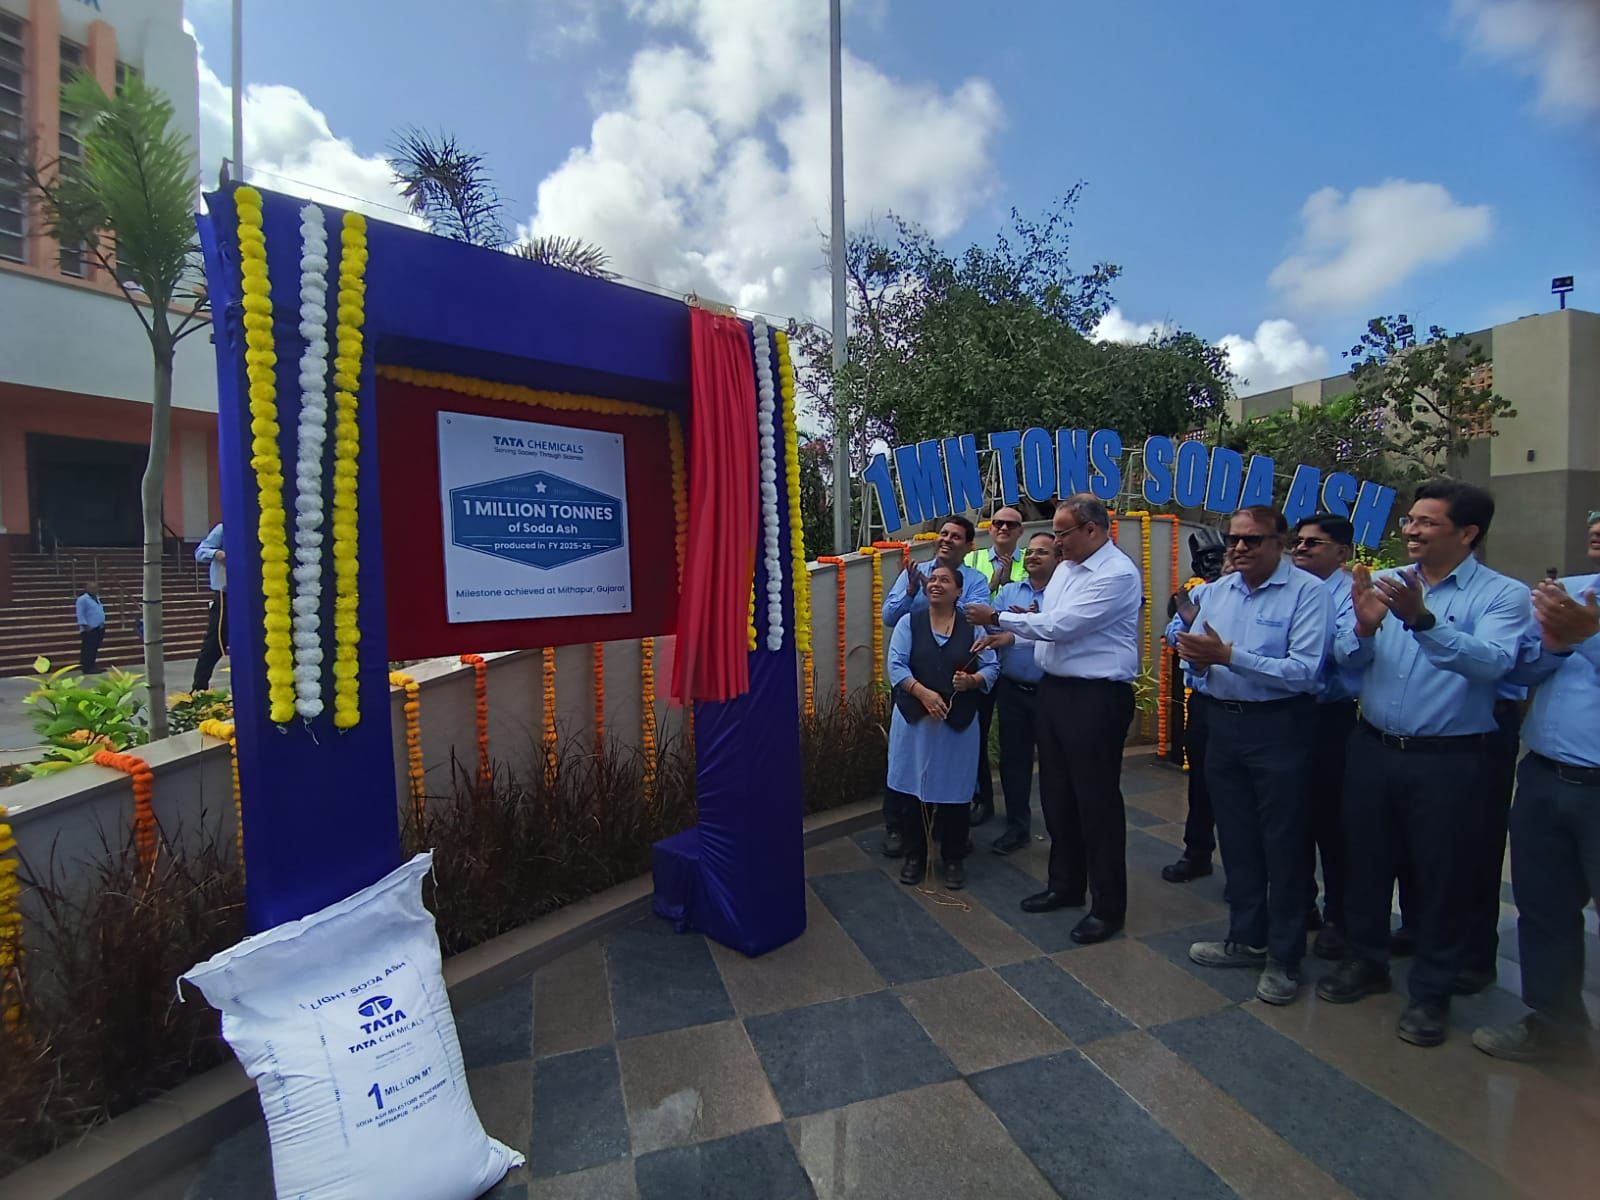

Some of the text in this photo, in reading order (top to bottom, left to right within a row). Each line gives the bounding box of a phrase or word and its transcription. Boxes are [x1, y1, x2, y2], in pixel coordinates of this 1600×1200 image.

[493, 435, 584, 454] TATA CHEMICALS
[988, 427, 1122, 506] TONS
[1142, 435, 1274, 514] SODA
[1282, 464, 1397, 550] ASH
[463, 500, 613, 521] 1 MILLION TONNES
[508, 522, 578, 534] of Soda Ash
[494, 541, 536, 551] produced
[537, 541, 545, 550] in
[548, 542, 558, 550] FY
[456, 584, 625, 598] Milestone achieved at Mithapur, Gujarat
[310, 991, 347, 1010] LIGHT
[350, 975, 383, 994] SODA
[384, 961, 406, 977] ASH
[360, 1009, 407, 1035] TATA
[348, 1038, 377, 1054] TATA
[367, 1065, 432, 1110] 1 MILLION MT
